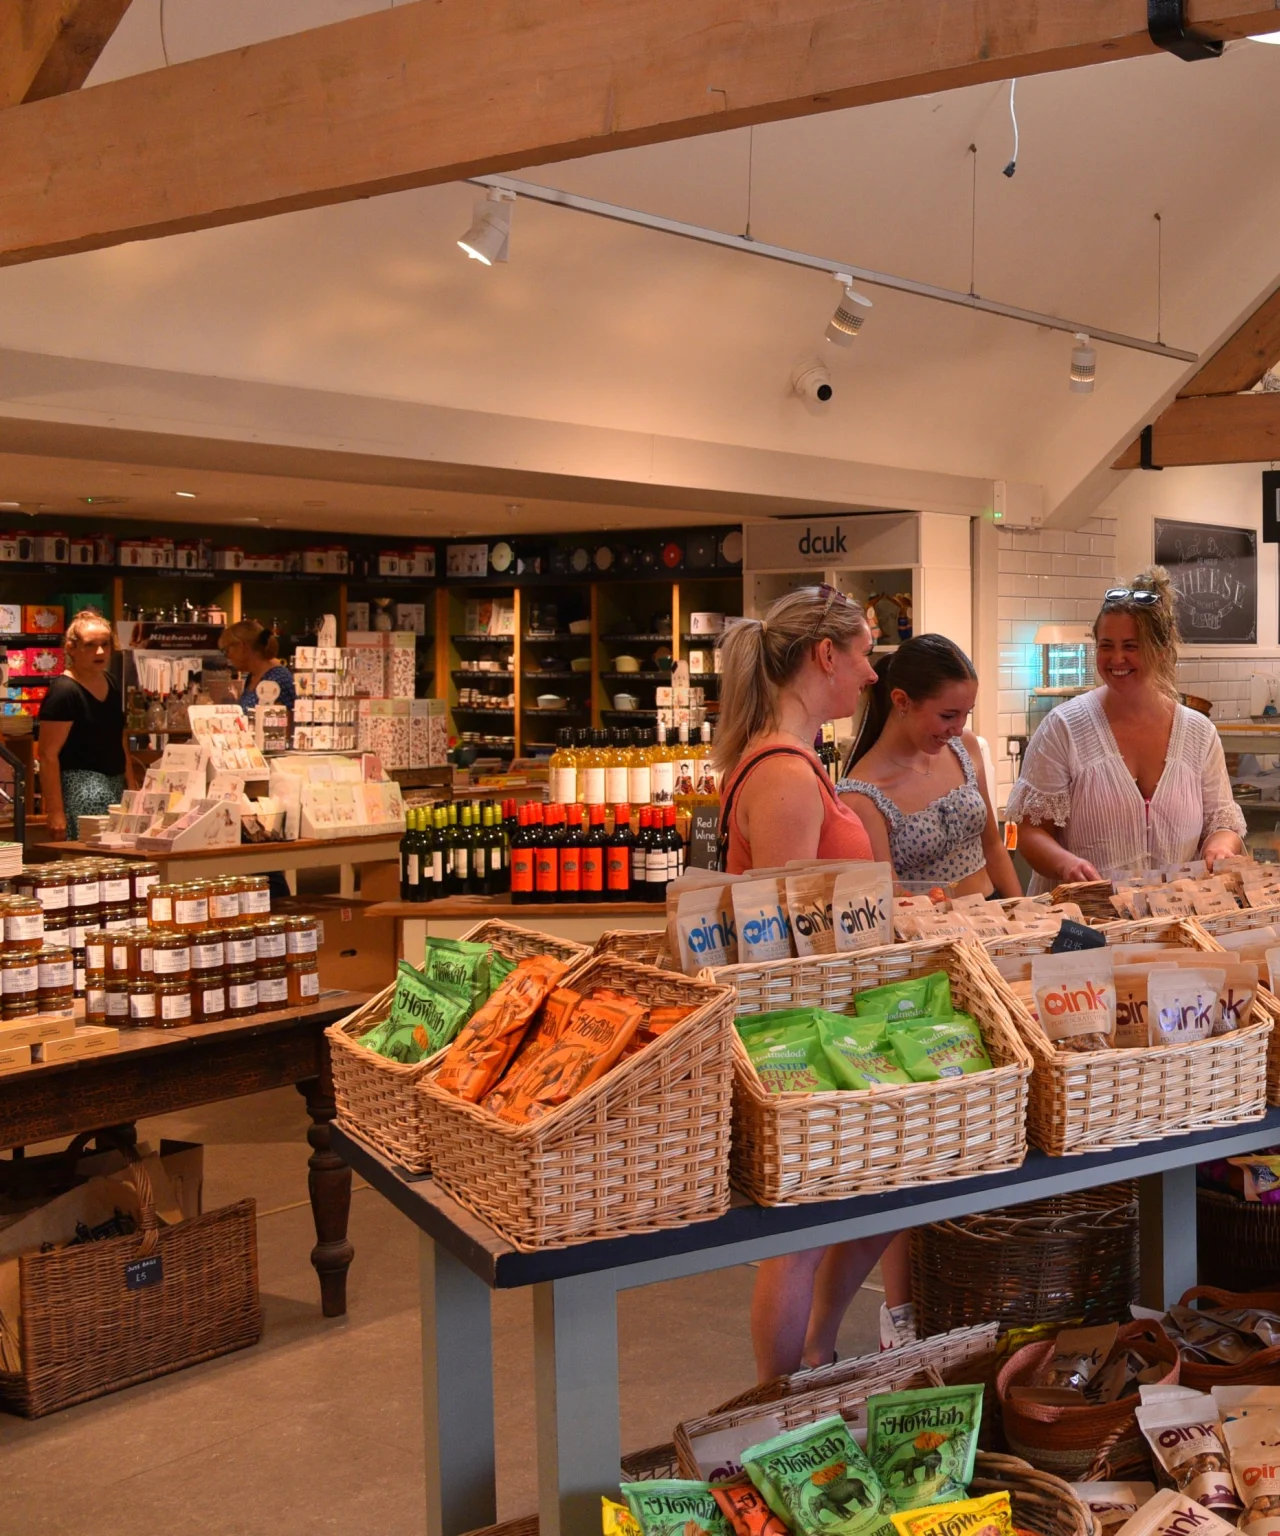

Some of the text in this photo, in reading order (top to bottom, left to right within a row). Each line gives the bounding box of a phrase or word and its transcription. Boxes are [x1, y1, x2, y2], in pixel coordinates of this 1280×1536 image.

[798, 526, 848, 555] dcuk
[150, 633, 208, 641] KitchenAid
[695, 830, 716, 841] Wine
[696, 816, 713, 828] Red
[688, 911, 738, 953] oink
[742, 905, 790, 945] oink
[794, 902, 833, 937] oink
[840, 896, 878, 934] oink
[398, 988, 445, 1035] Howdah
[1044, 980, 1108, 1016] oink
[1116, 994, 1148, 1026] oin
[1158, 994, 1213, 1033] oink
[572, 1012, 617, 1046] Howdah
[880, 1405, 964, 1436] Howdah
[1158, 1423, 1217, 1448] oink
[768, 1434, 846, 1475] Howdah
[1158, 1507, 1209, 1536] ink
